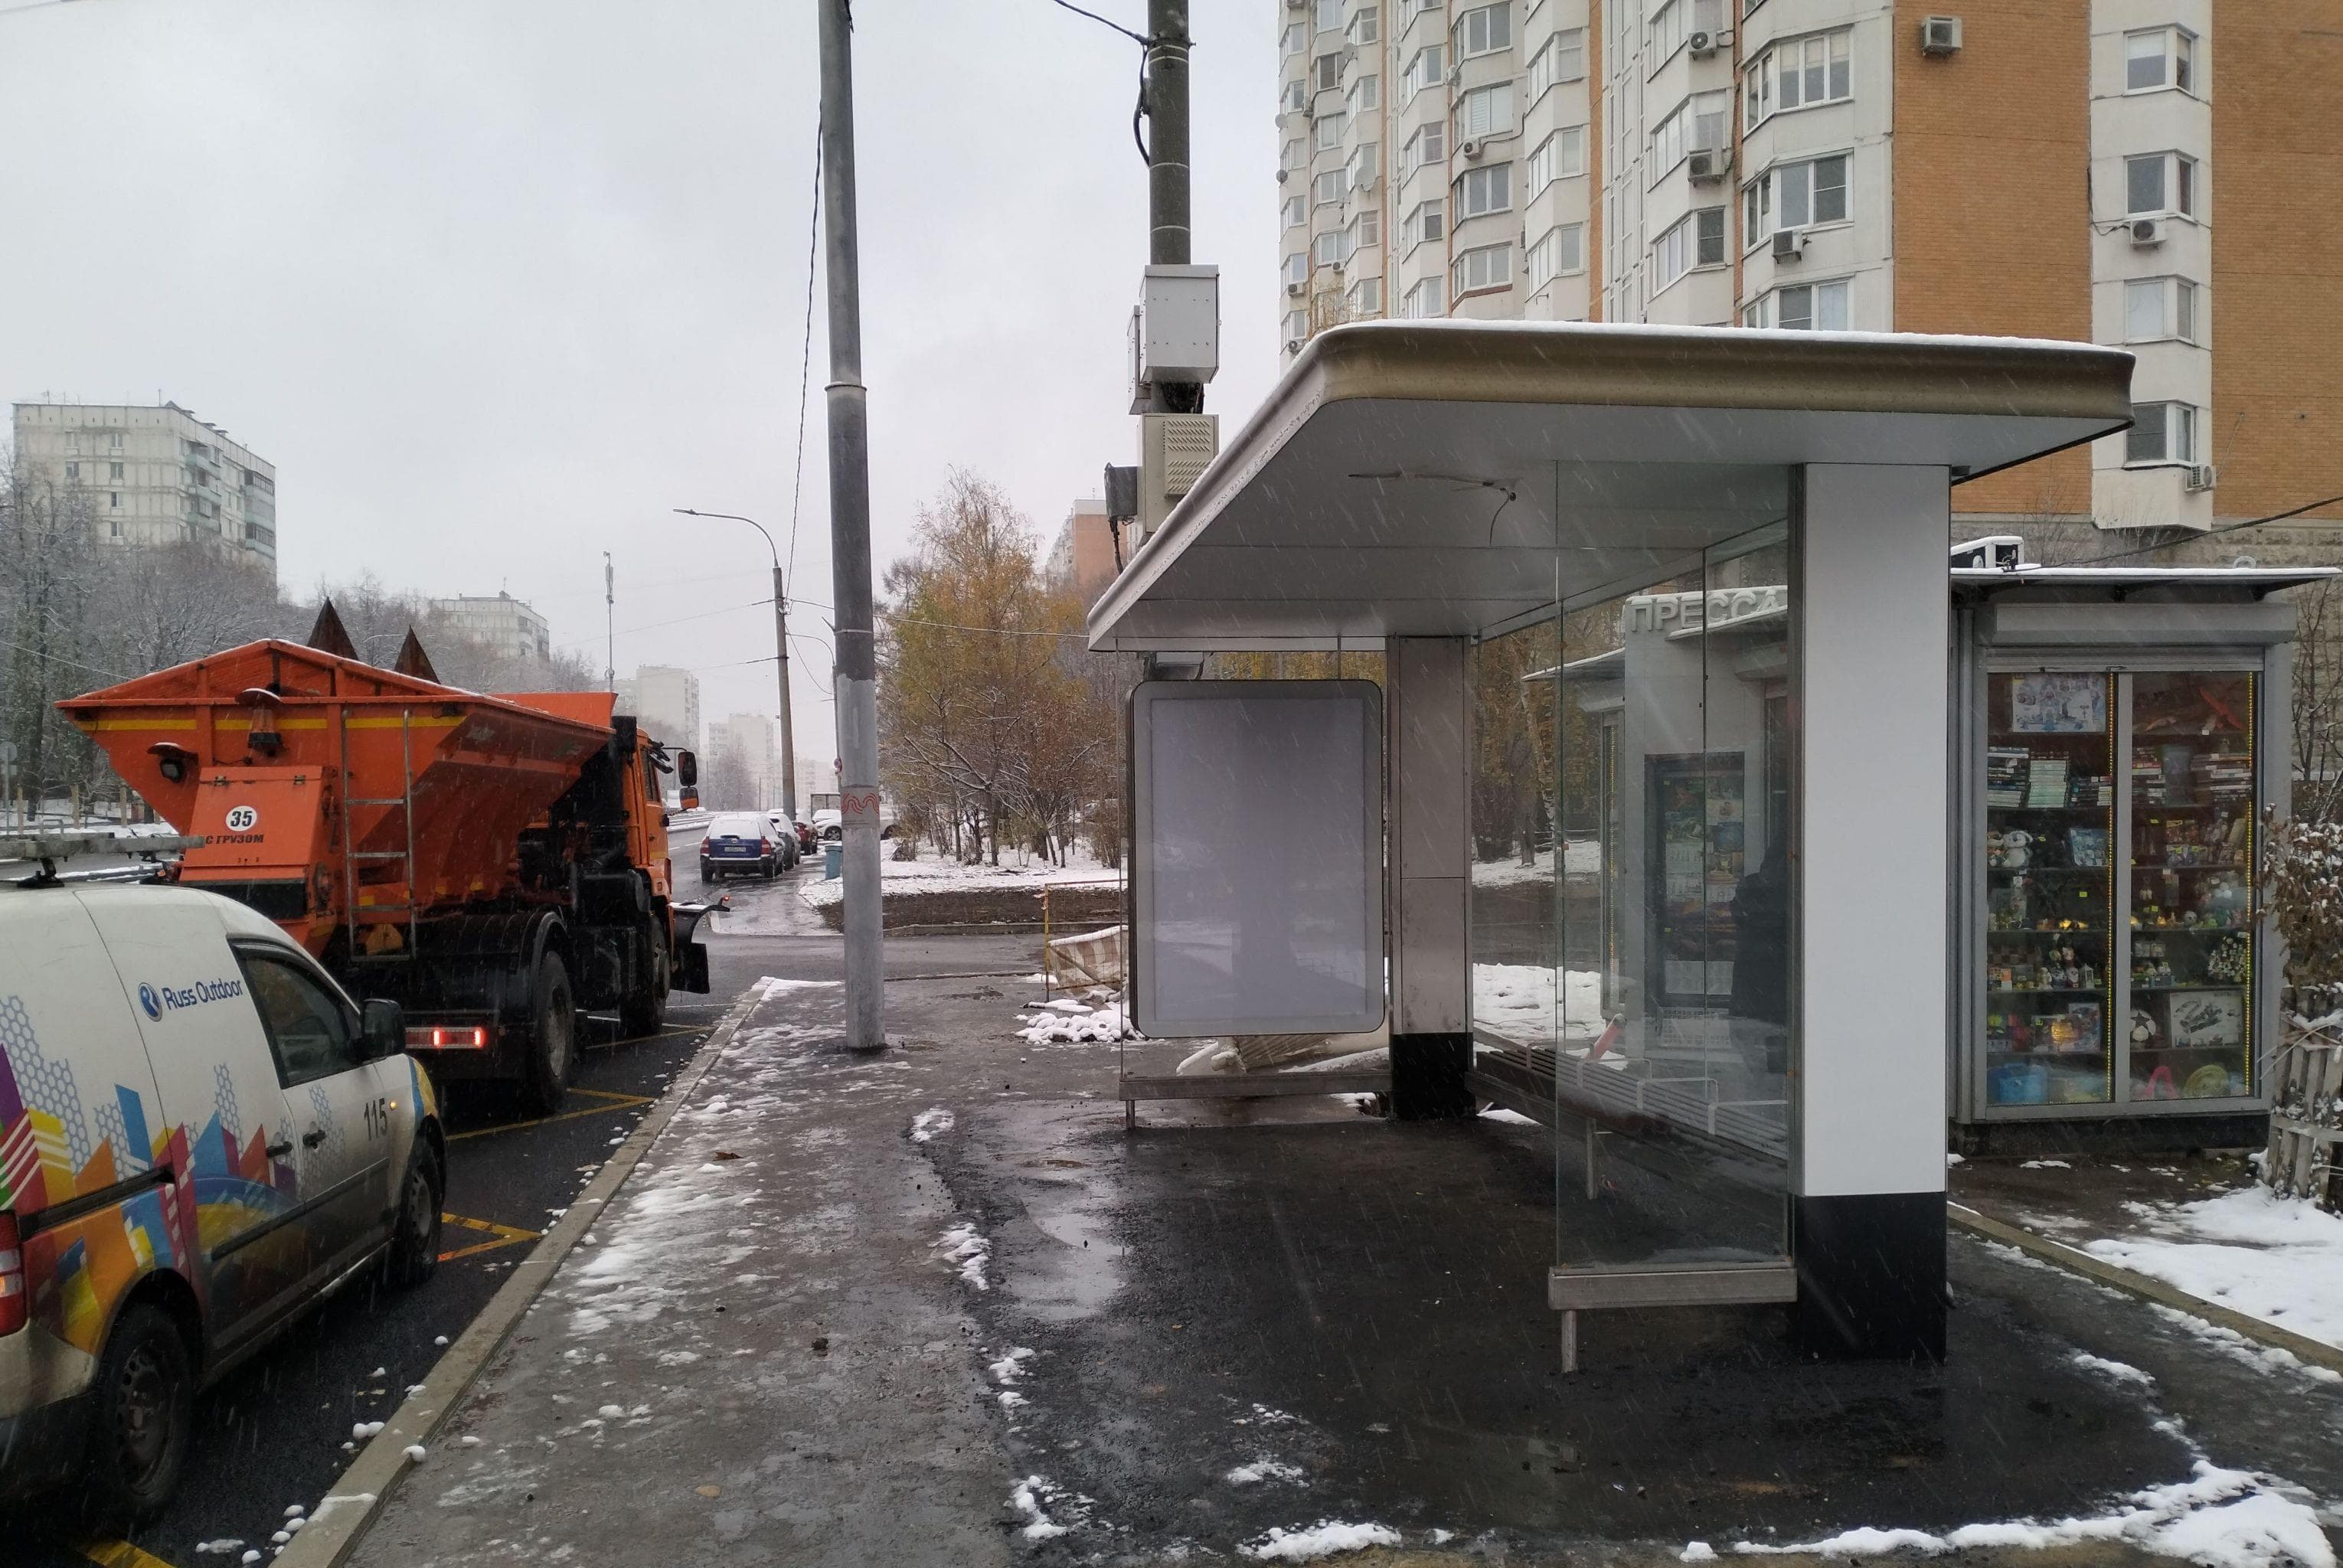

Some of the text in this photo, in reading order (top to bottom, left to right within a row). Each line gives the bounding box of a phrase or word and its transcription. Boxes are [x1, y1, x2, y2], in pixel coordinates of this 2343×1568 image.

[1630, 589, 1780, 632] ПРЕССА
[230, 811, 253, 827] 35
[205, 835, 264, 844] С ГРУЗОМ
[162, 978, 243, 1010] Russ Outdoor
[364, 1097, 388, 1141] 115
